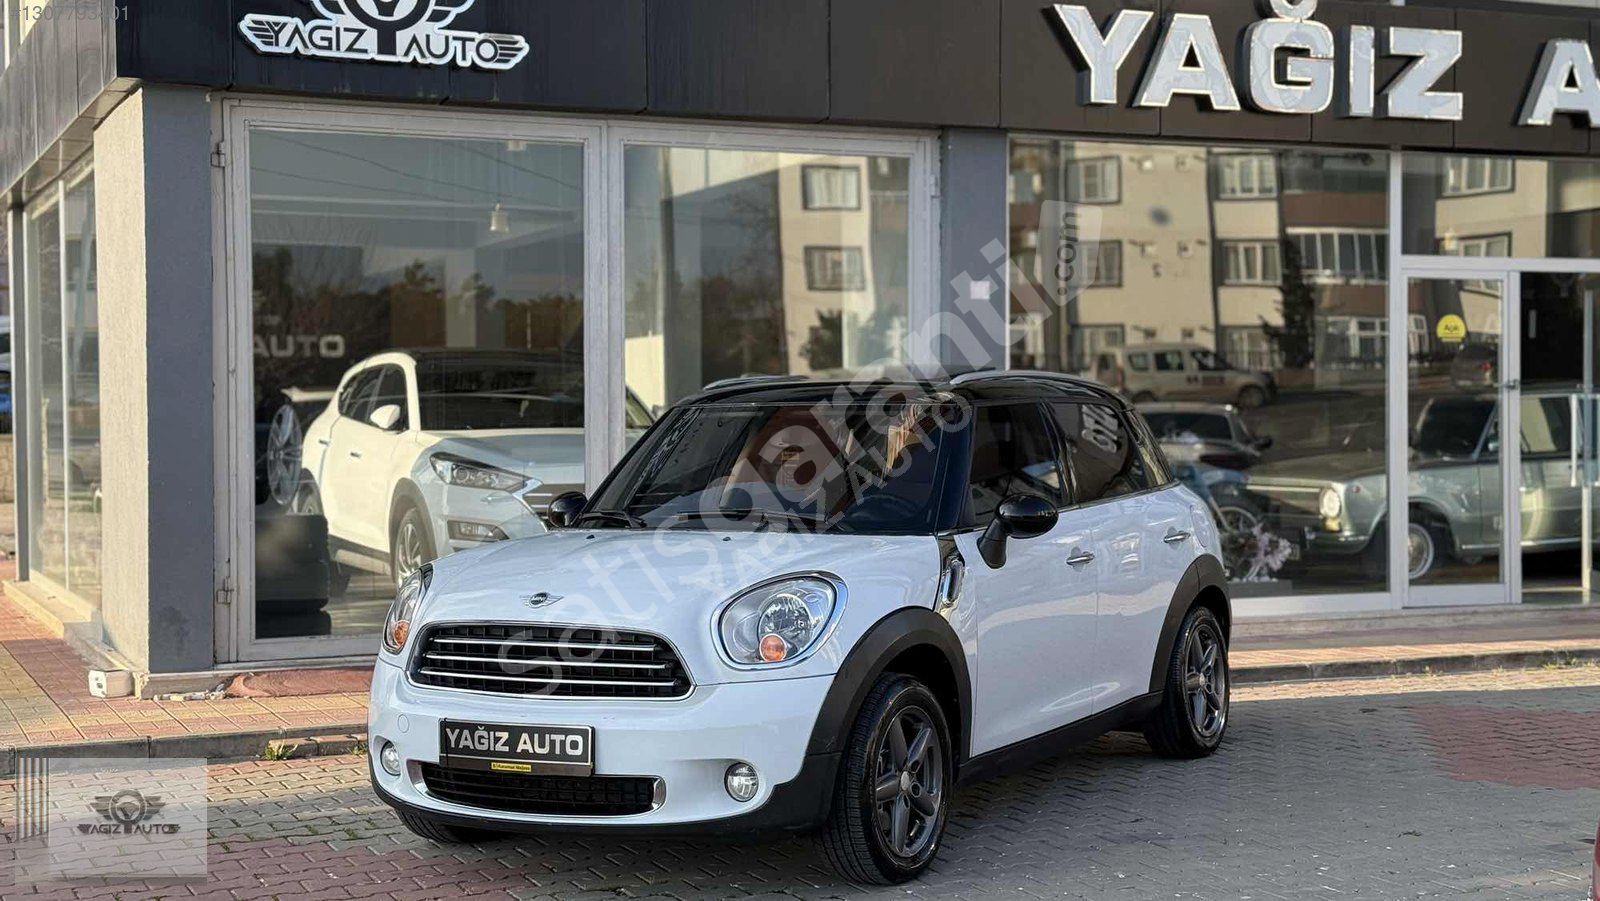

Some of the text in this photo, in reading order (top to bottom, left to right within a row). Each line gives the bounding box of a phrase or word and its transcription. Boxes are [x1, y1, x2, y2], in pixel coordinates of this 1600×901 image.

[403, 33, 500, 63] AUTO
[1053, 0, 1463, 120] YAĞIZ
[446, 725, 583, 756] YAĞIZ AUTO
